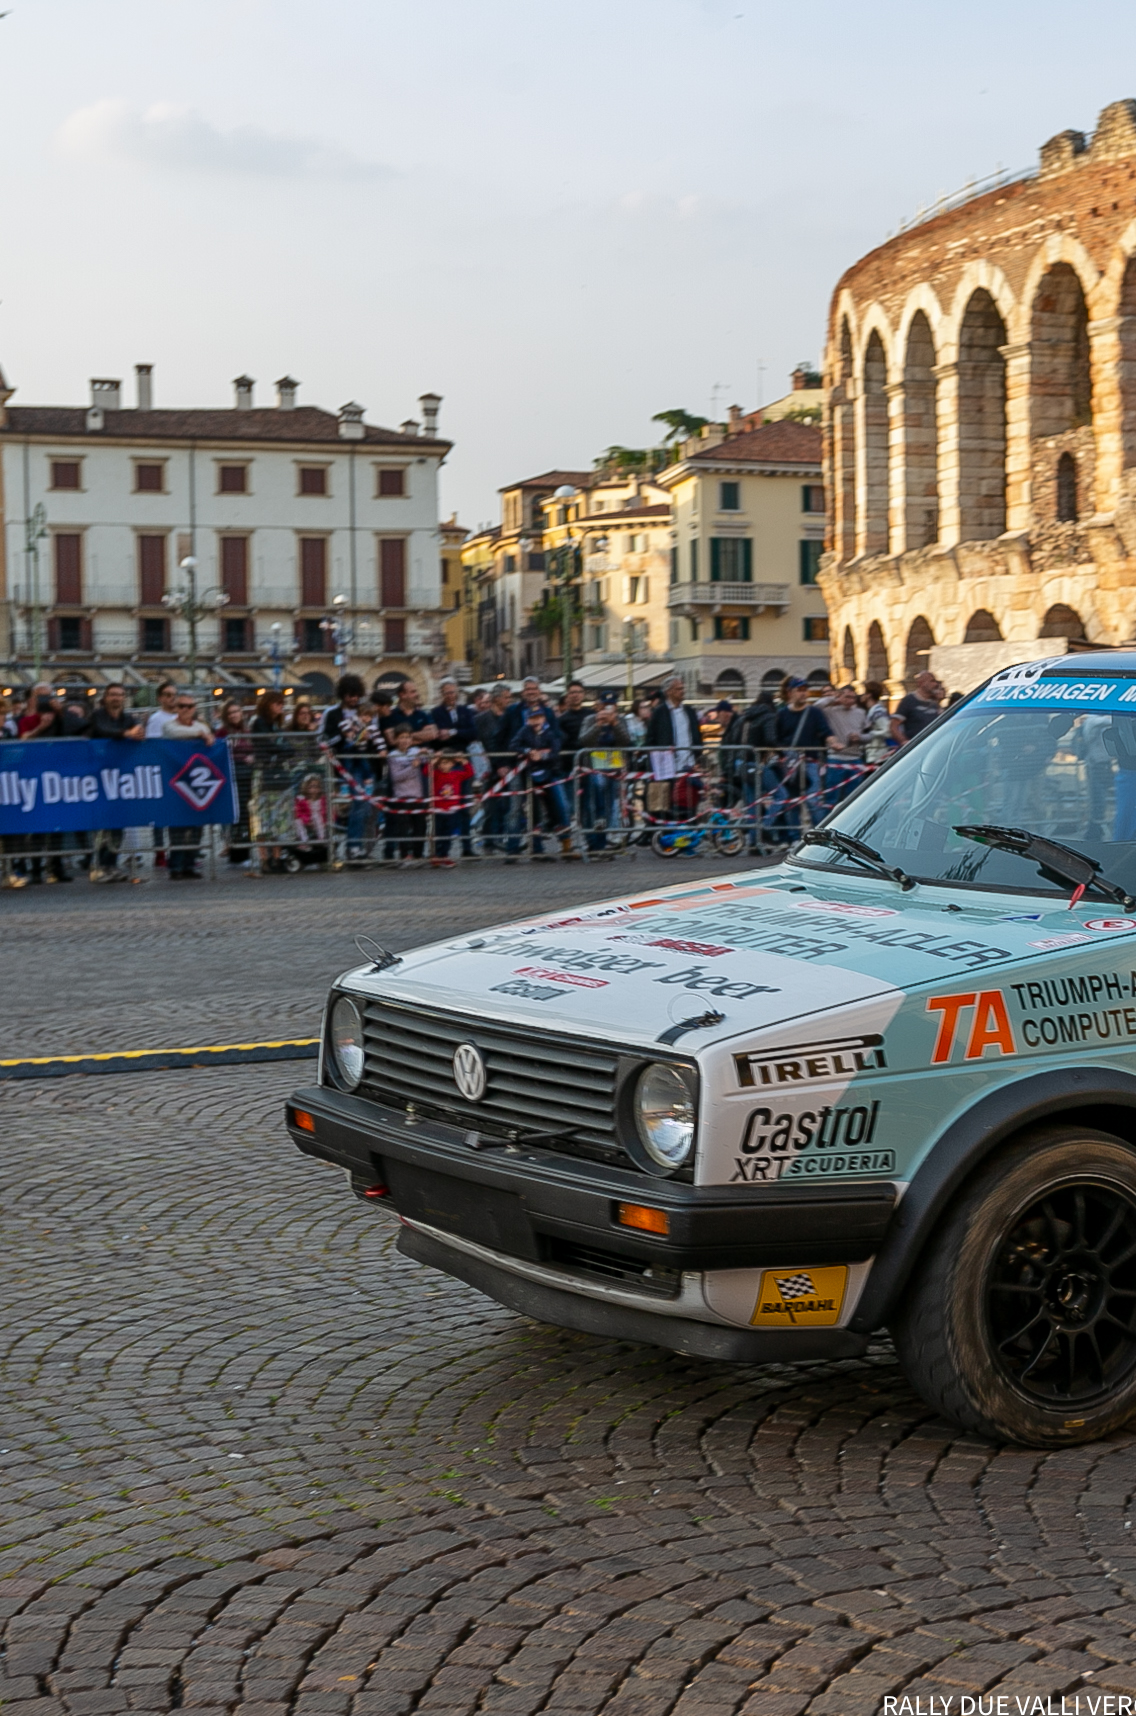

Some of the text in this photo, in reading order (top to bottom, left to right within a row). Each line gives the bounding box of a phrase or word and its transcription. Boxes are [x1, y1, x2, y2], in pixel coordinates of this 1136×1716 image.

[977, 683, 1117, 702] VOLKSWAGEN
[0, 765, 163, 812] lly Due Valli
[625, 917, 850, 960] COMPUTER
[689, 903, 1012, 967] TRIUMPH-ADLER
[652, 965, 783, 1000] beer
[925, 989, 1017, 1065] TA
[731, 1033, 888, 1088] PIRELLI
[741, 1100, 882, 1154] Castrol
[729, 1153, 891, 1182] XRT SCUDERIA
[760, 1299, 838, 1314] BARDAHL
